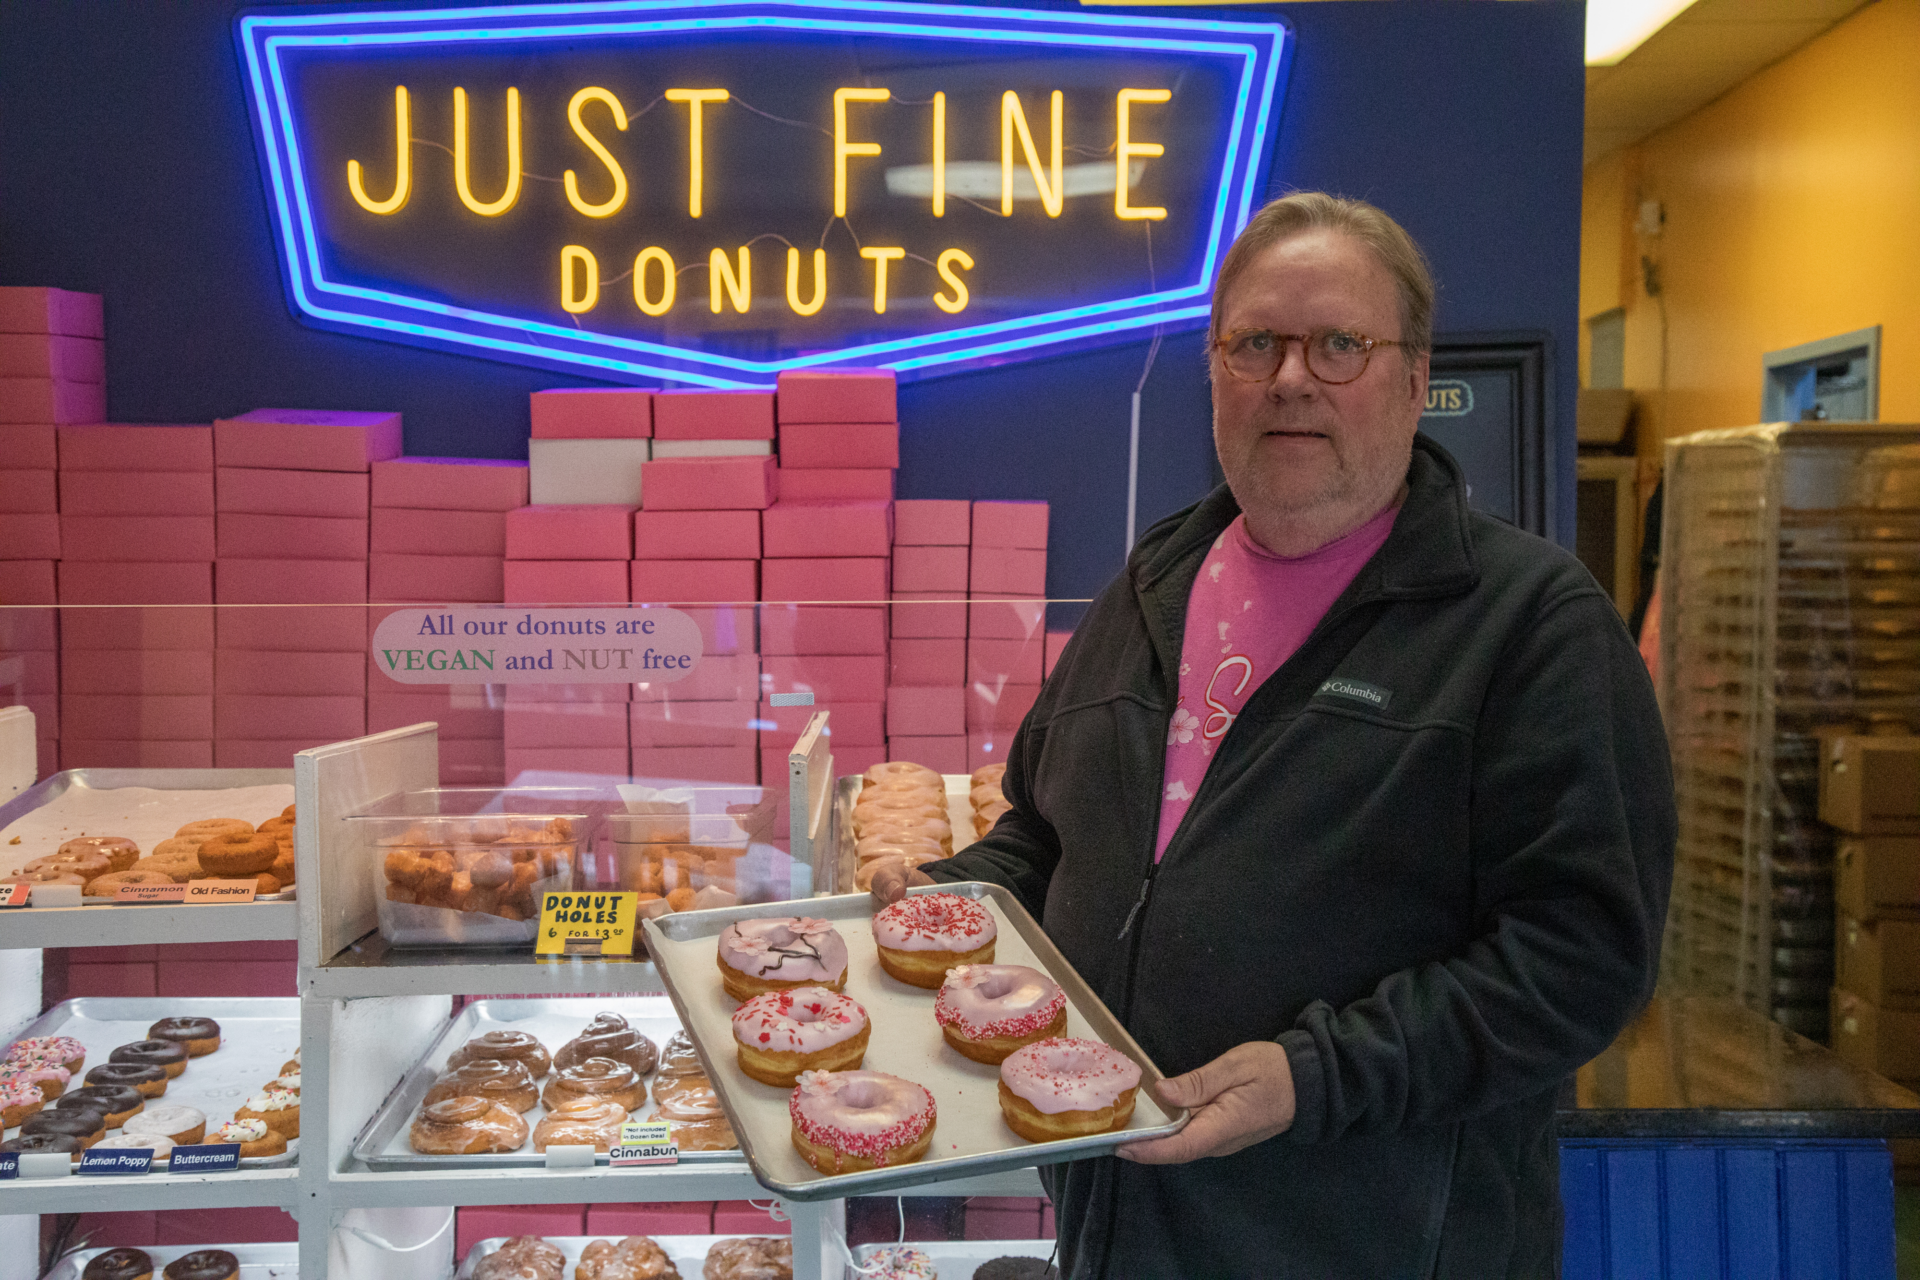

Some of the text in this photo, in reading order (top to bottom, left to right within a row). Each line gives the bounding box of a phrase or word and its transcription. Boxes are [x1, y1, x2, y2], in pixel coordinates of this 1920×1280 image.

[347, 85, 1172, 220] JUST FINE
[560, 244, 974, 316] DONUTS
[417, 614, 655, 636] All our donuts are
[382, 648, 691, 671] VEGAN and NUT free
[1331, 682, 1382, 702] Columbia
[191, 887, 250, 895] Old Fashion
[546, 895, 623, 911] DONUT
[555, 910, 617, 924] HOLES
[548, 927, 557, 938] 6
[174, 1153, 235, 1165] Buttercream
[610, 1146, 678, 1158] Cinnabun
[83, 1155, 149, 1167] Lemon Poppy
